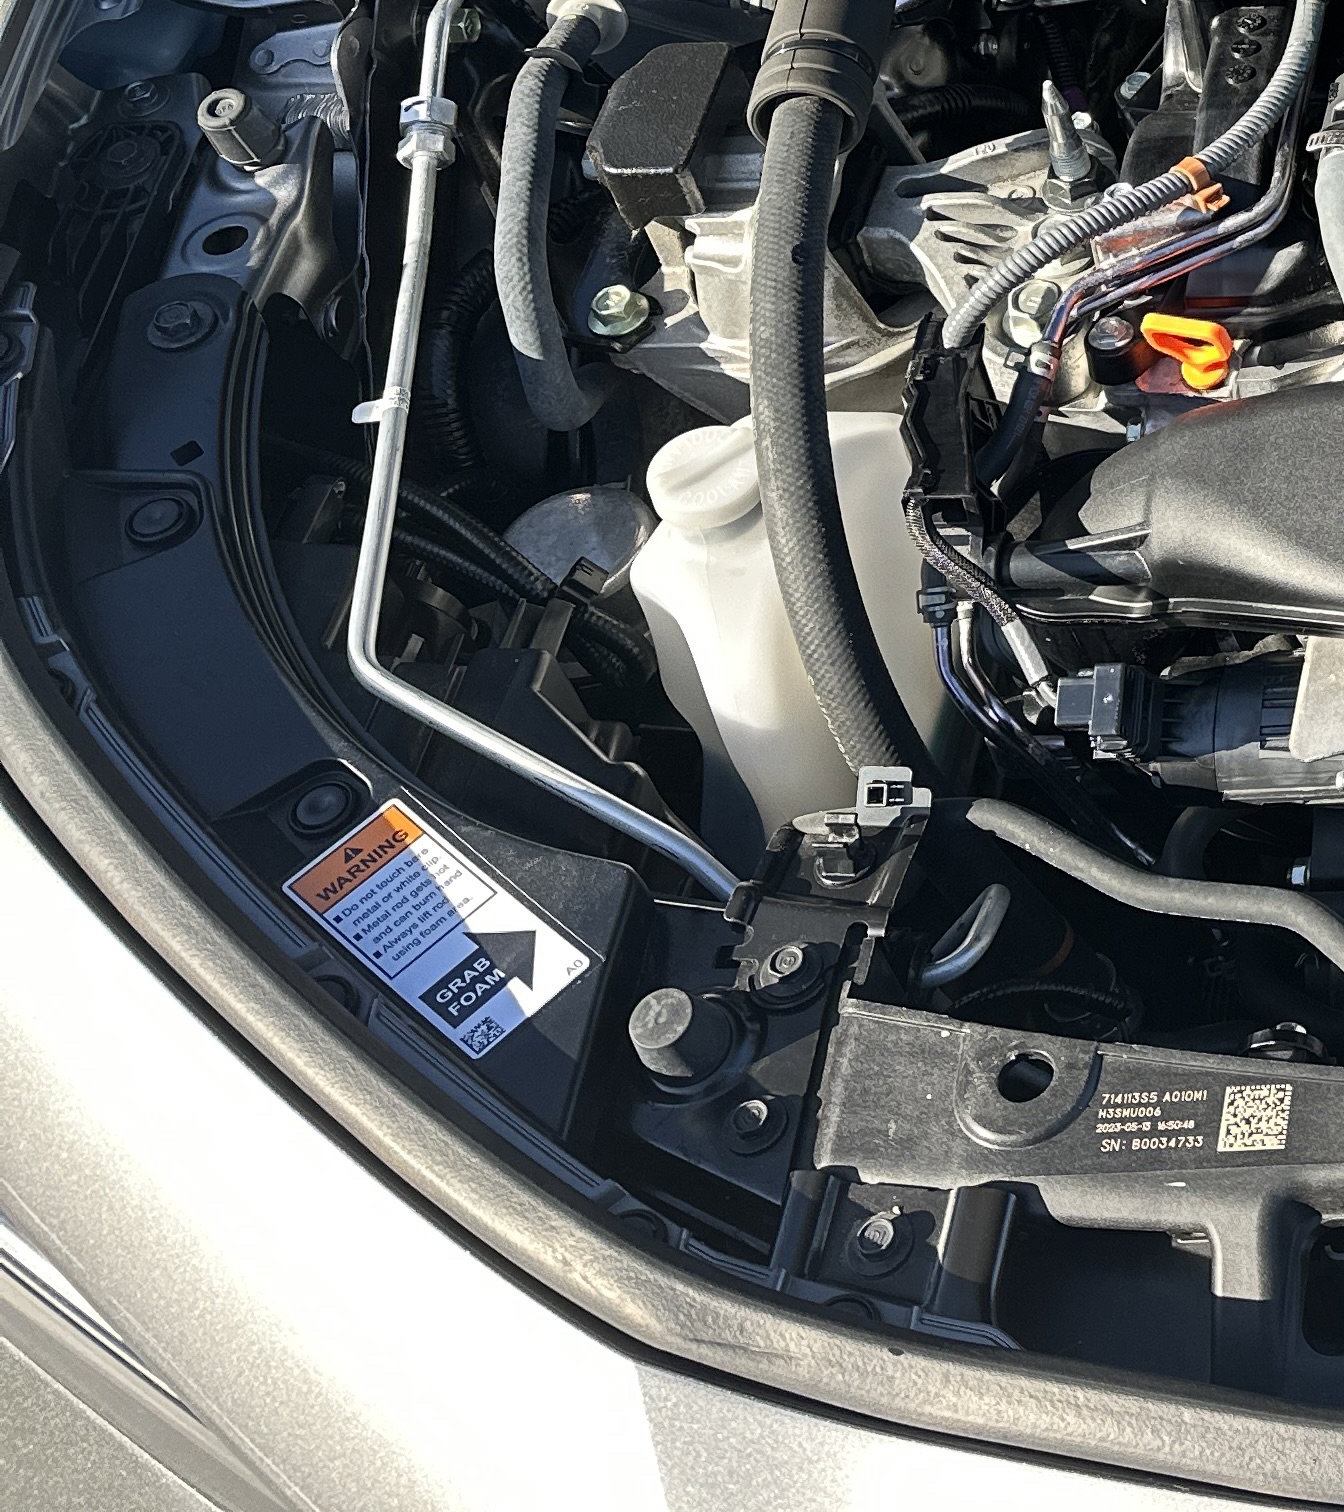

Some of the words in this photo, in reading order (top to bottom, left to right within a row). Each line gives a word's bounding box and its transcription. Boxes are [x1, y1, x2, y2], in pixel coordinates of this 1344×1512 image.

[316, 829, 409, 901] WARNING
[342, 903, 360, 918] Do
[360, 890, 376, 905] not
[376, 866, 406, 890] touch
[404, 848, 429, 867] bare
[352, 901, 382, 927] metal
[382, 892, 394, 904] or
[393, 871, 421, 893] white
[361, 908, 393, 936] Metal
[392, 896, 410, 914] rod
[411, 879, 434, 897] gets
[372, 926, 393, 944] and
[394, 910, 414, 927] can
[413, 891, 438, 911] burn
[438, 869, 464, 891] hand
[382, 922, 419, 954] Always
[417, 909, 431, 924] lift
[431, 896, 450, 913] rod
[391, 938, 422, 963] using
[419, 916, 447, 939] foam
[436, 957, 491, 1003] GRAB
[448, 968, 506, 1016] FOAM
[1098, 1106, 1162, 1119] H3SMU006
[1101, 1091, 1158, 1105] 714113S5
[1163, 1090, 1208, 1102] A010M1
[1096, 1121, 1151, 1133] 2023-05-13
[1100, 1138, 1127, 1153] SN:
[1131, 1136, 1204, 1150] B0034733
